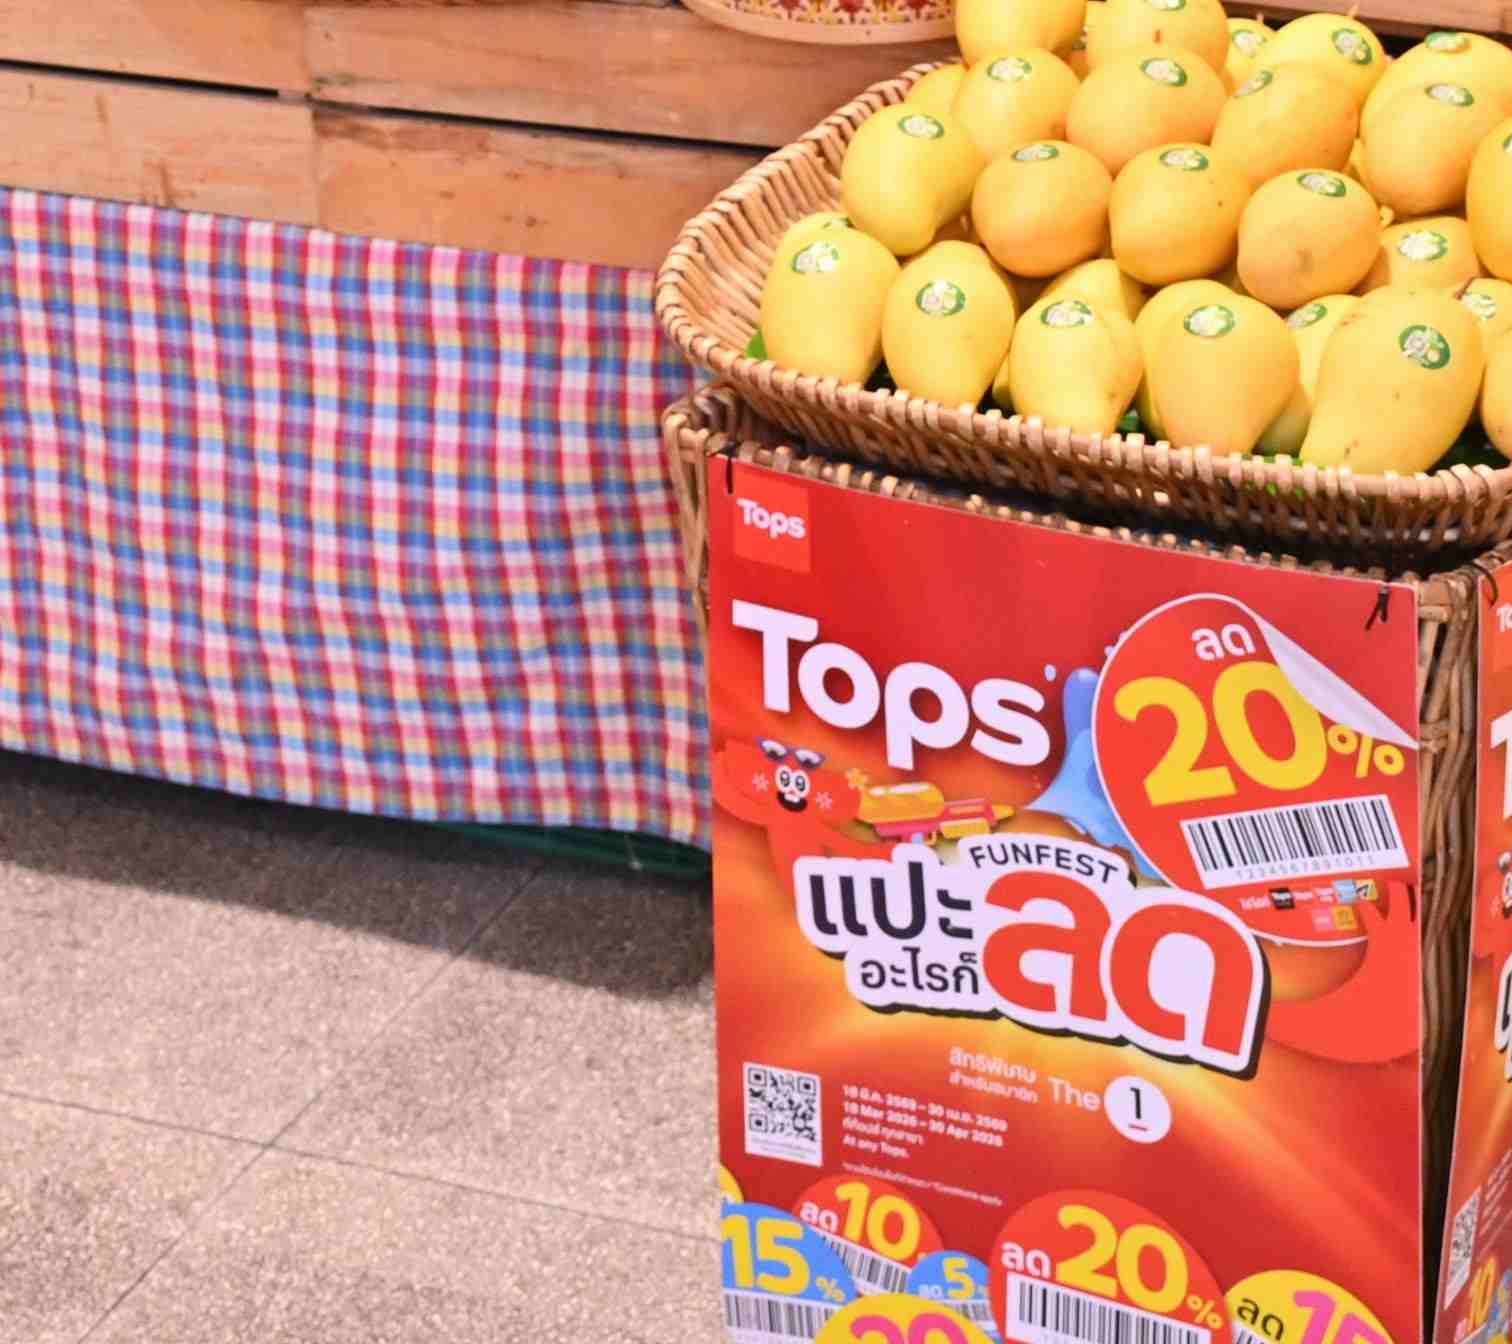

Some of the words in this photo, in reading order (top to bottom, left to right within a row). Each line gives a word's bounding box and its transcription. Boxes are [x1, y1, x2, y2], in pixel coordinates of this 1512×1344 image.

[736, 498, 806, 539] Tops
[1191, 623, 1257, 661] ลด
[732, 599, 1050, 771] Tops
[969, 845, 1119, 885] FUNFEST
[809, 860, 974, 941] แปะ
[982, 870, 1254, 1057] ลด
[861, 947, 980, 995] อะไรก็
[1047, 1076, 1101, 1111] The
[860, 1104, 884, 1120] Mar
[946, 1122, 968, 1141] Apr
[843, 1134, 857, 1147] At
[858, 1137, 878, 1153] any
[800, 1200, 839, 1233] ลด
[1001, 1241, 1051, 1278] ลด
[1236, 1296, 1286, 1342] ลด
